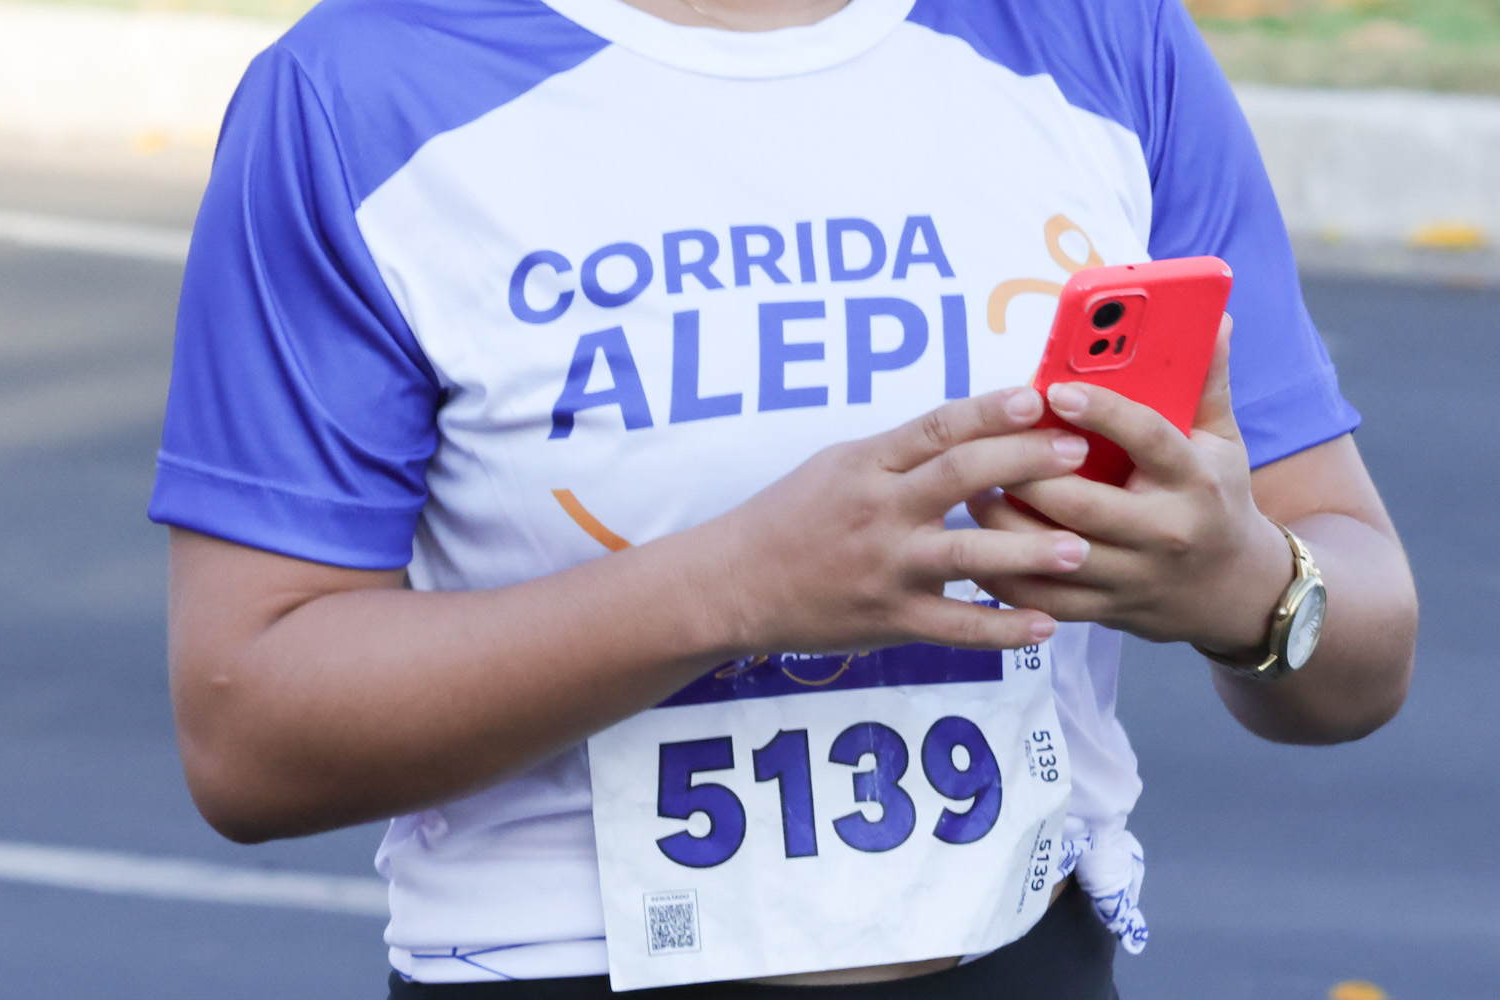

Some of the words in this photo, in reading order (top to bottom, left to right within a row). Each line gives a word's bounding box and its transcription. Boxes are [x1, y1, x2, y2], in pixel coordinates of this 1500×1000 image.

[508, 214, 956, 325] CORRIDA
[547, 293, 971, 440] ALEPI
[1023, 644, 1041, 670] 39
[655, 715, 1003, 869] 5139
[1032, 730, 1059, 783] 5139
[1030, 839, 1052, 892] 5139
